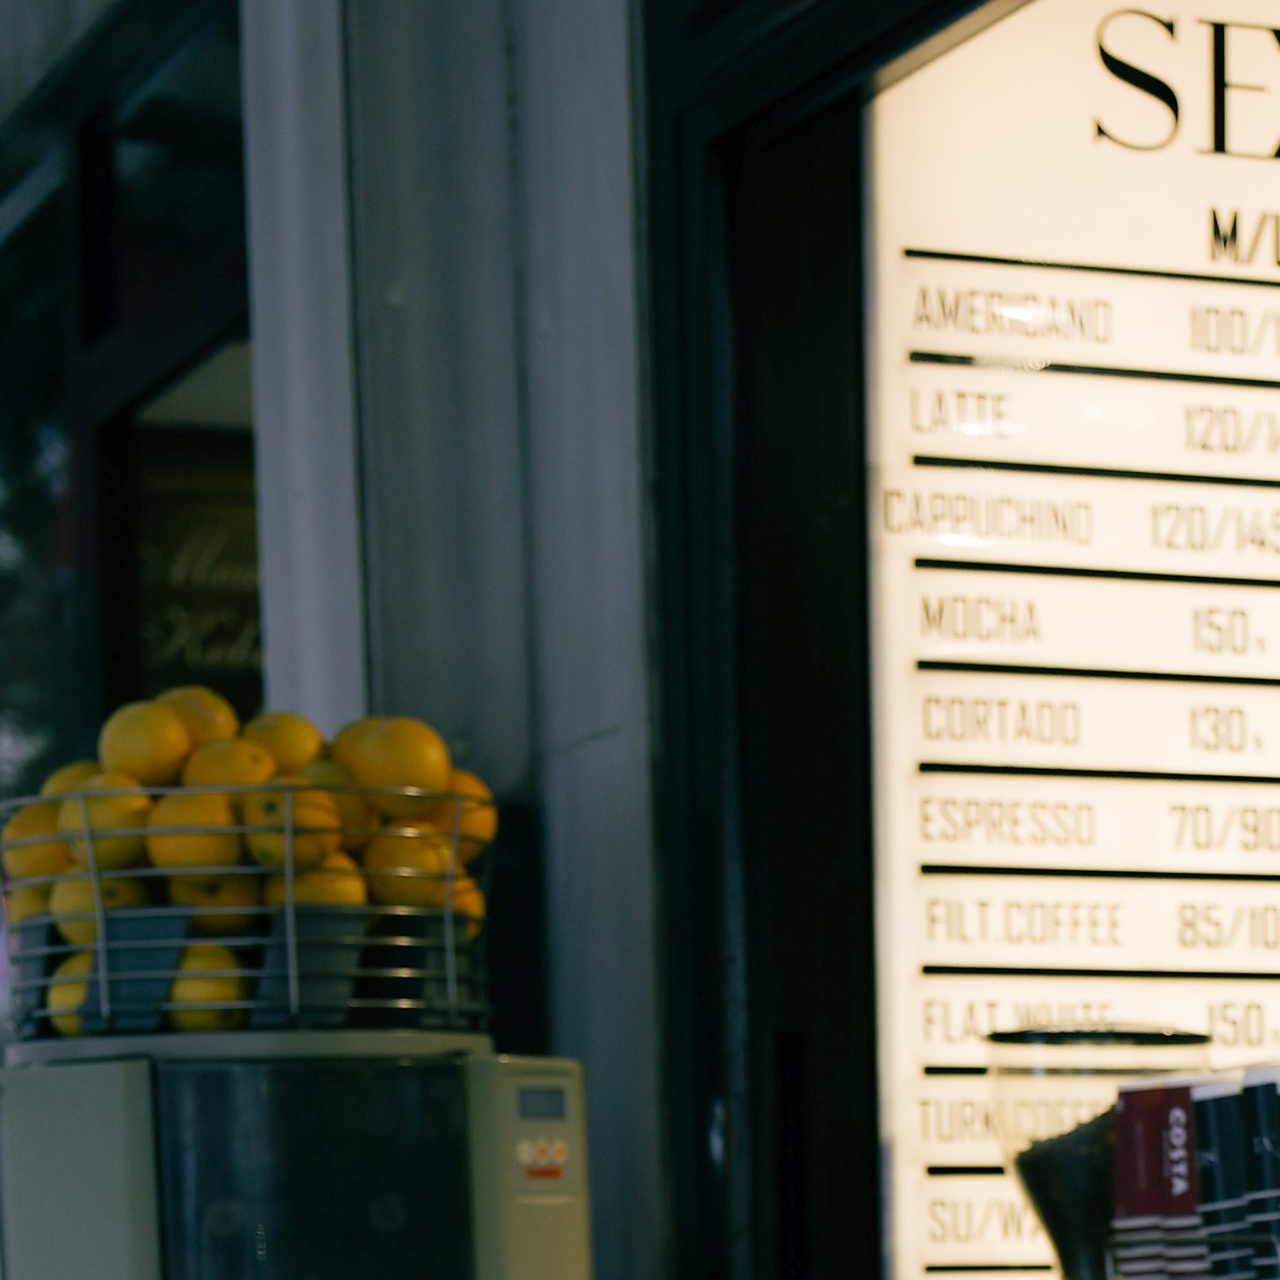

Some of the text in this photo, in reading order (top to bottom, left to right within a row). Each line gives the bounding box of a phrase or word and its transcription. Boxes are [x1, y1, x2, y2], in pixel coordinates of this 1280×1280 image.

[913, 284, 1112, 344] AMERICANO
[908, 388, 1012, 440] LATTE
[919, 593, 1044, 643] MOCHA
[921, 695, 1082, 746] CORTADO
[919, 797, 1097, 847] ESPRESSO
[922, 998, 998, 1045] FLAT
[1167, 1105, 1190, 1197] COSTA
